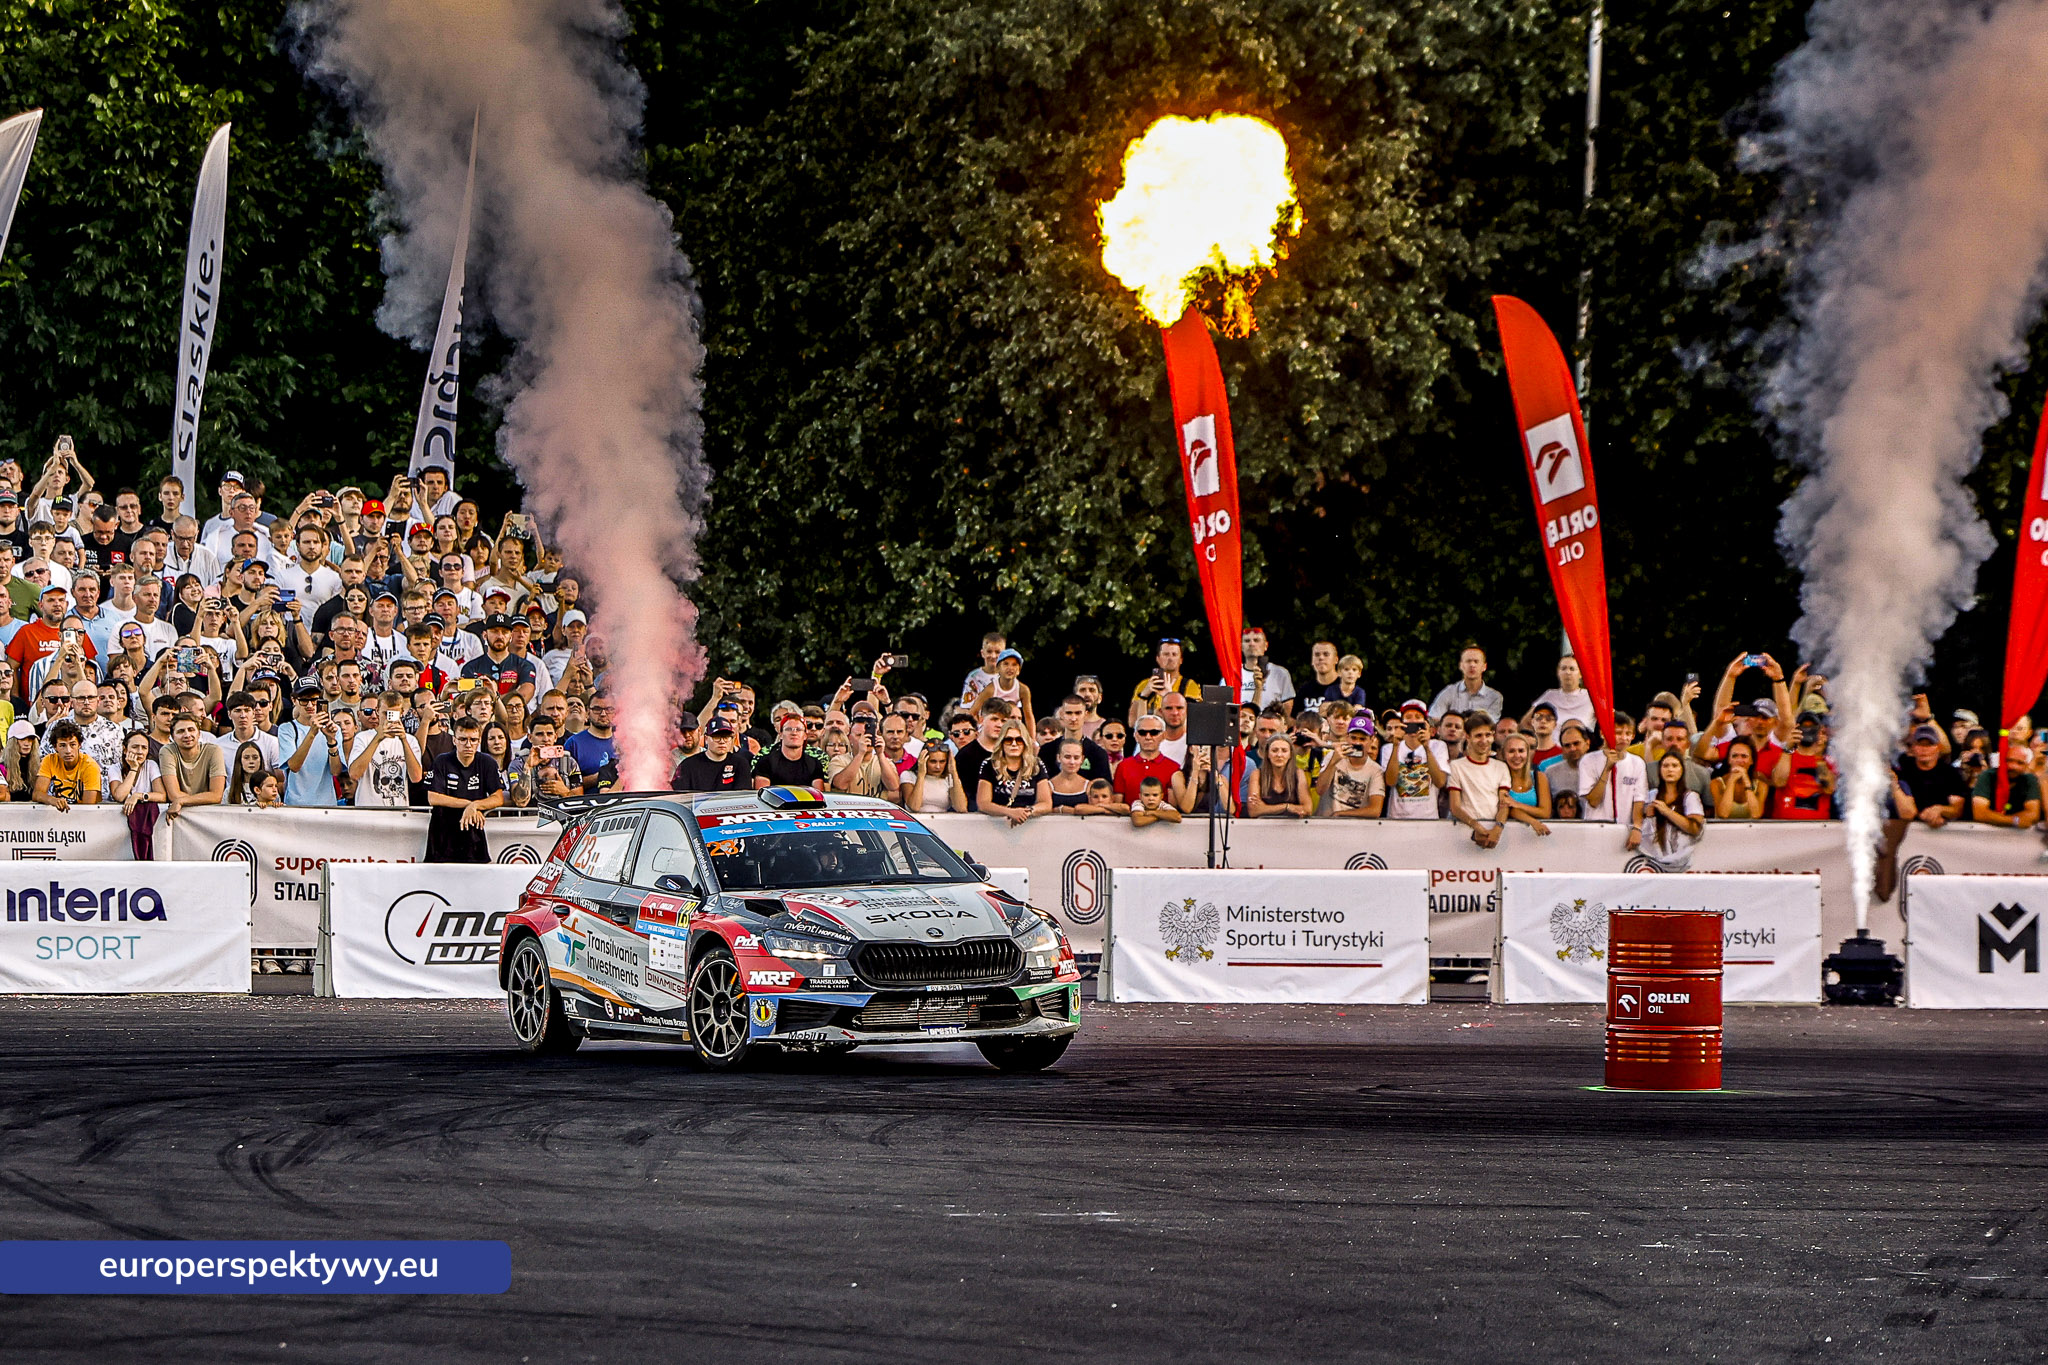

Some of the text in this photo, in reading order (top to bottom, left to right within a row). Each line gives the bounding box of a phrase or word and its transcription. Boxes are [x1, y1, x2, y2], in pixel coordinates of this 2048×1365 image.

[717, 810, 894, 826] MRF TYRES
[47, 828, 86, 847] ŚLĄSKI
[574, 835, 597, 869] 23
[706, 839, 739, 857] 23
[274, 881, 319, 900] STAD
[6, 881, 168, 922] interia
[1429, 894, 1481, 913] ADION
[1226, 905, 1345, 924] Ministerstwo
[820, 929, 851, 941] HOFFMAN
[1226, 929, 1384, 952] Sportu i Turystyki
[1724, 928, 1776, 948] ystyki
[36, 936, 141, 960] SPORT
[587, 930, 638, 967] Transilvania
[587, 951, 639, 988] Investments
[748, 970, 796, 986] MRF
[1647, 993, 1690, 1003] ORLEN
[1647, 1005, 1664, 1014] OIL
[788, 1032, 816, 1040] Mobil
